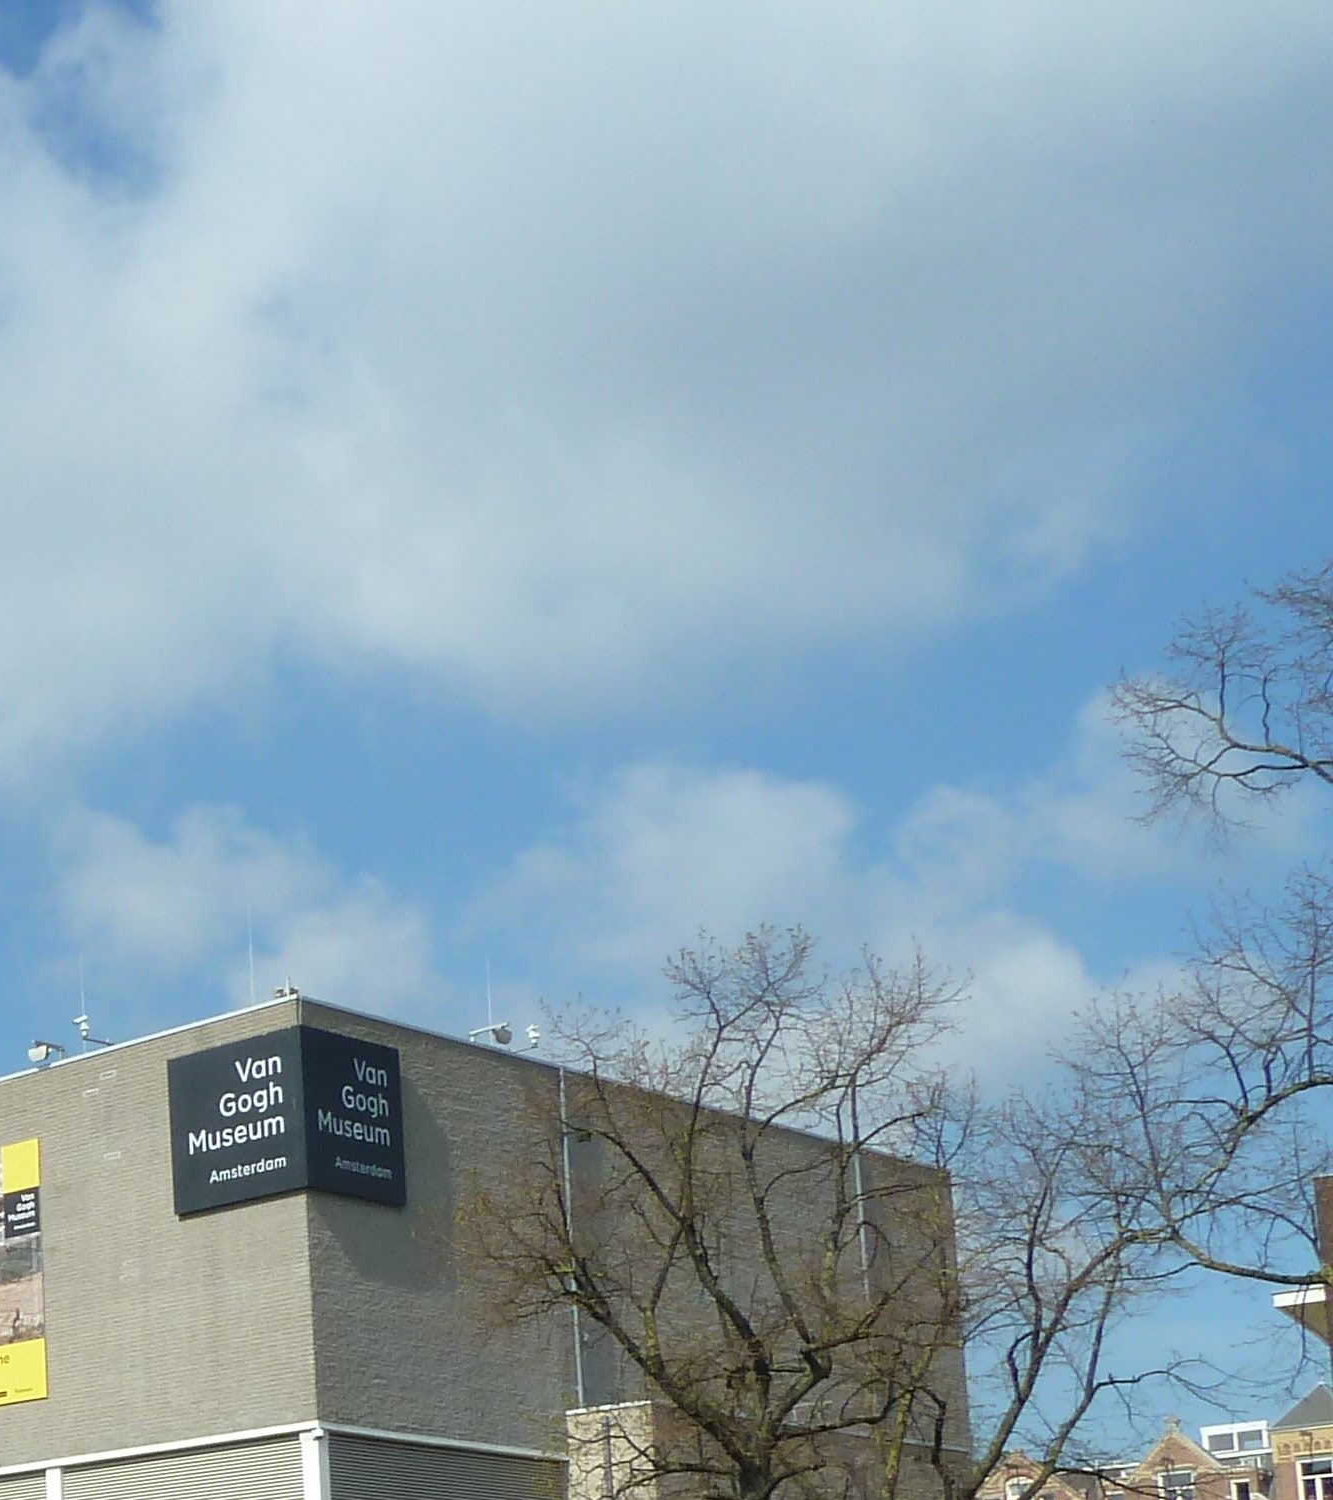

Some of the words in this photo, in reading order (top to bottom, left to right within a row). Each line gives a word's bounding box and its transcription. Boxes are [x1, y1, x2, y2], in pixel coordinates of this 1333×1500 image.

[235, 1055, 282, 1083] Van
[353, 1058, 388, 1088] Van
[219, 1081, 284, 1117] Gogh
[341, 1085, 389, 1118] Gogh
[188, 1115, 285, 1155] Museum
[317, 1109, 391, 1147] Museum
[209, 1155, 287, 1184] Amsterdam
[335, 1156, 392, 1180] Amsterdam
